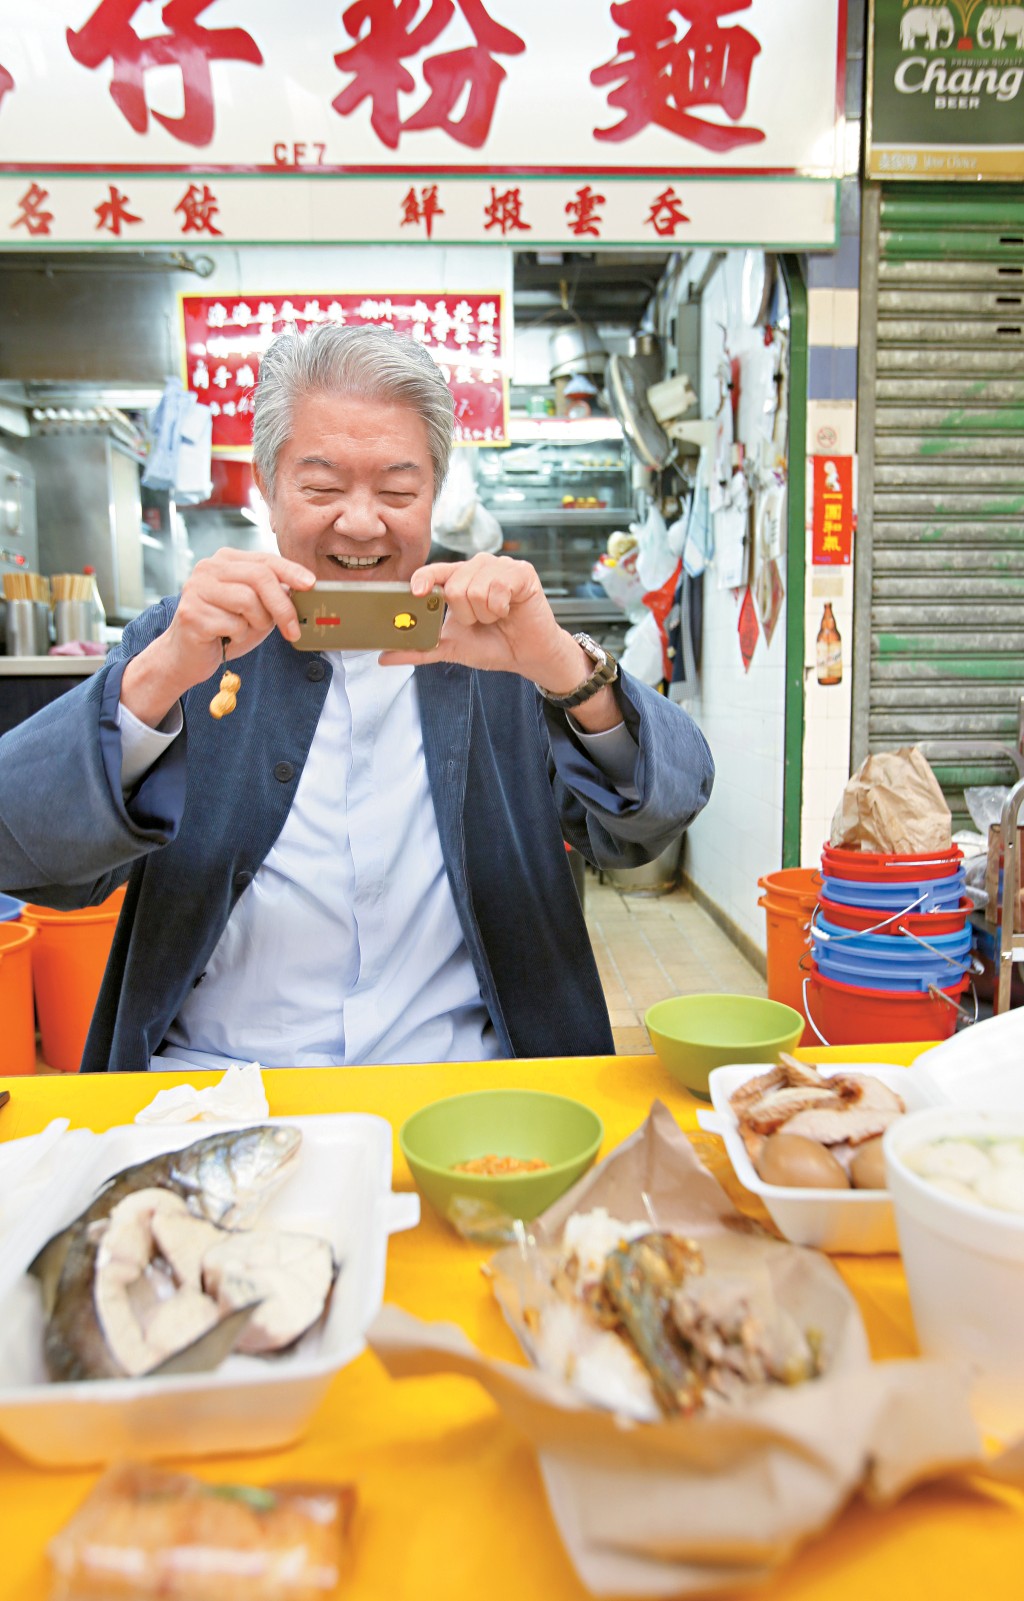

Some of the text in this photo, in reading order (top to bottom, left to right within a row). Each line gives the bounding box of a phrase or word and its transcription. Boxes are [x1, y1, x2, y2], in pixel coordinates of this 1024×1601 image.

[0, 0, 765, 152] 仔粉麵
[894, 56, 1024, 101] Chang
[934, 96, 980, 110] BEER
